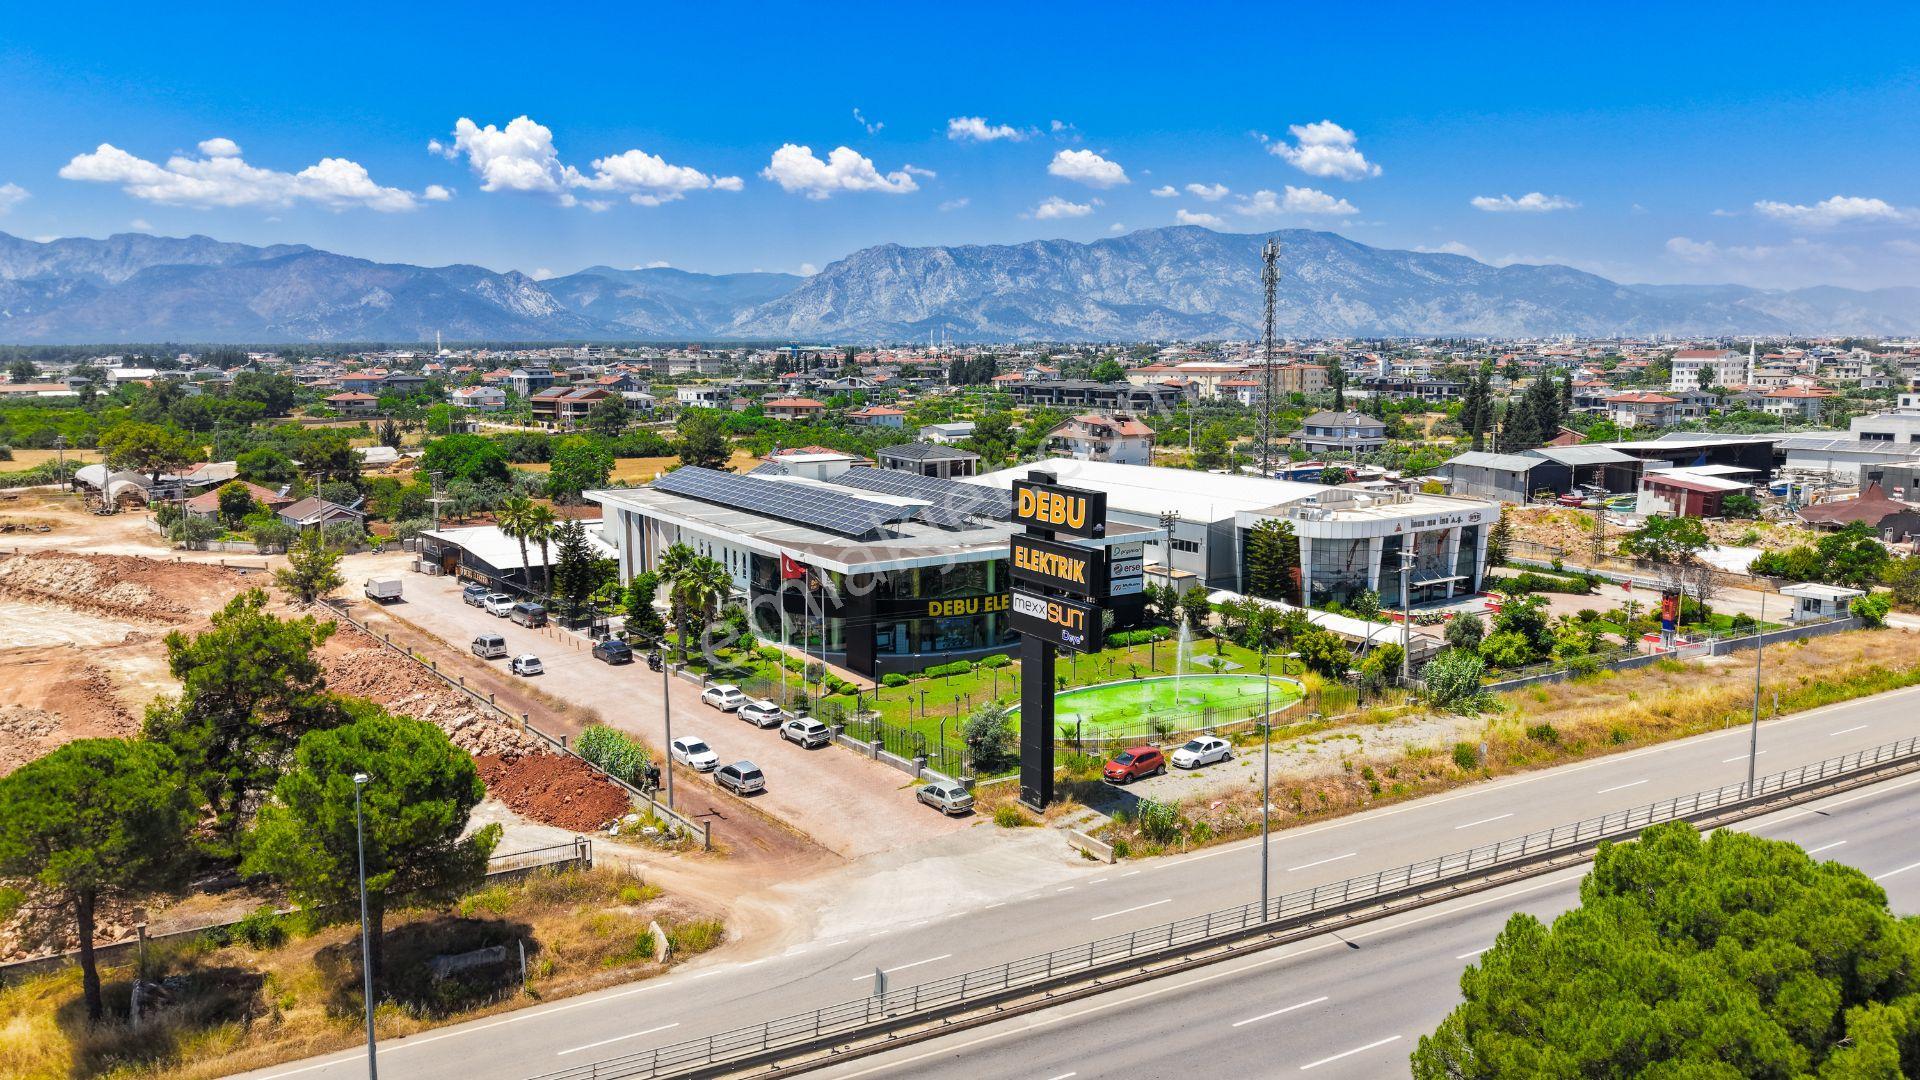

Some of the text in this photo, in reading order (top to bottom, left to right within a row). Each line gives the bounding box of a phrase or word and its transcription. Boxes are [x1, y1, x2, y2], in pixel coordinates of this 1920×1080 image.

[1018, 487, 1086, 529] DEBU
[1123, 564, 1141, 573] erse
[928, 598, 979, 617] DEBU
[1014, 597, 1046, 616] mexx
